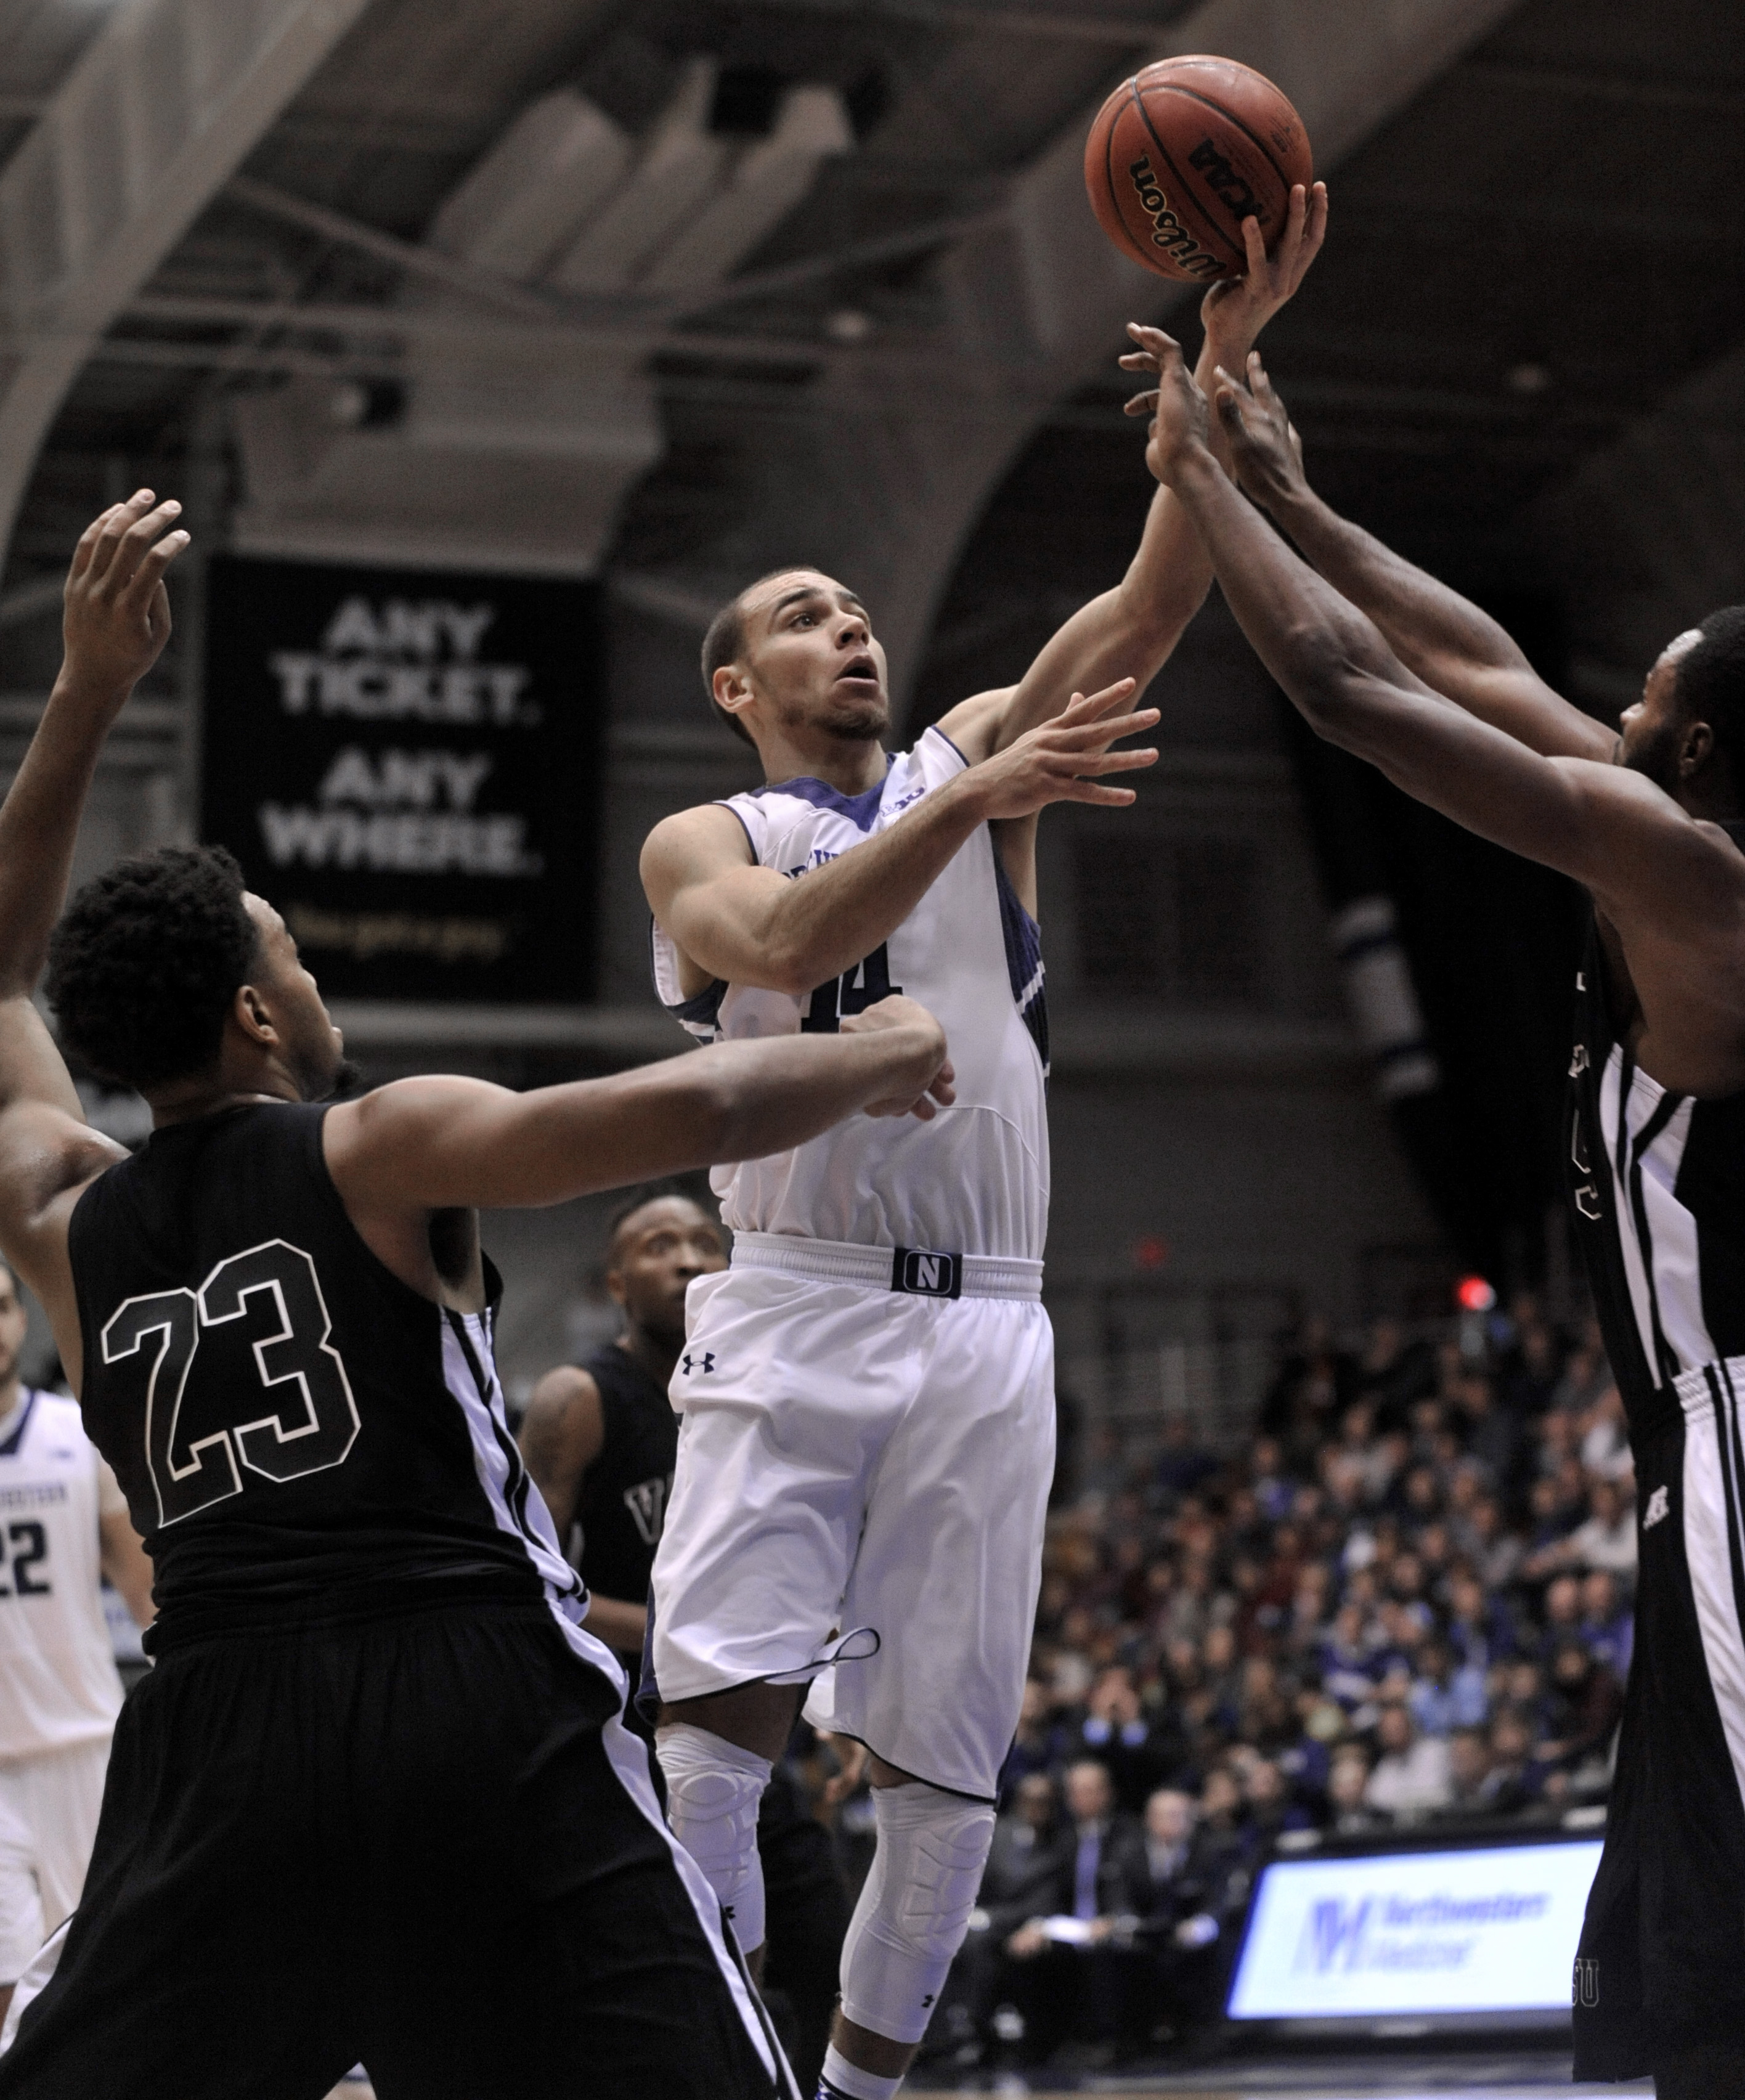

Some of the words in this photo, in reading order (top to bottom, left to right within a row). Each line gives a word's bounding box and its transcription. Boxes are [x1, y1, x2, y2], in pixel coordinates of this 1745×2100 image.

[320, 596, 495, 657] ANY
[317, 746, 494, 808] ANY
[800, 942, 903, 1033] 14
[916, 1255, 940, 1290] N
[100, 1237, 362, 1529] 23
[0, 1521, 51, 1597] 2
